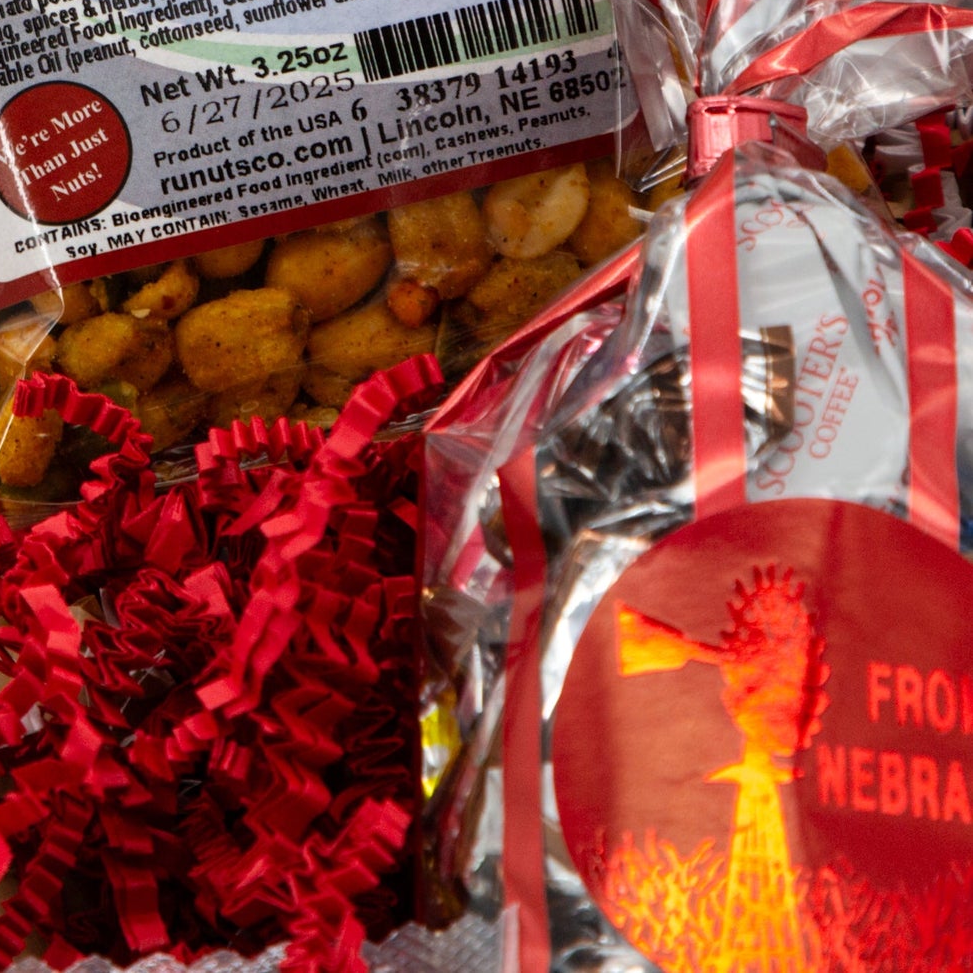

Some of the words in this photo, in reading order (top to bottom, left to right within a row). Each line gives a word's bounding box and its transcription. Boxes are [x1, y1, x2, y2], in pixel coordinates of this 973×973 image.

[38, 51, 60, 73] Oil
[66, 40, 136, 73] (peanut,
[140, 11, 240, 50] cottonseed,
[140, 76, 192, 107] Net
[195, 64, 245, 93] Wt.
[252, 42, 348, 78] 3.25oz
[50, 100, 103, 134] More
[161, 68, 355, 134] 6/27/2025
[351, 97, 367, 121] 6
[396, 72, 481, 111] 38379
[494, 49, 577, 90] 14193
[17, 150, 68, 186] Than
[71, 128, 109, 158] Just
[154, 136, 232, 167] Product
[238, 130, 256, 147] of
[260, 121, 293, 143] the
[298, 111, 342, 133] USA
[160, 135, 353, 195] runutsco.com
[379, 103, 491, 145] Lincoln,
[499, 87, 540, 115] NE
[14, 218, 107, 253] CONTAINS:
[111, 184, 233, 228] Bioengineered
[237, 172, 282, 198] Food
[285, 151, 373, 187] Ingredient
[49, 162, 103, 202] Nuts!
[107, 228, 146, 251] MAY
[151, 210, 233, 239] CONTAIN:
[238, 192, 308, 218] Sesame,
[422, 157, 463, 175] other
[757, 313, 849, 495] SCOOTER'S
[809, 374, 858, 460] COFFEE
[817, 744, 972, 825] NEBRA
